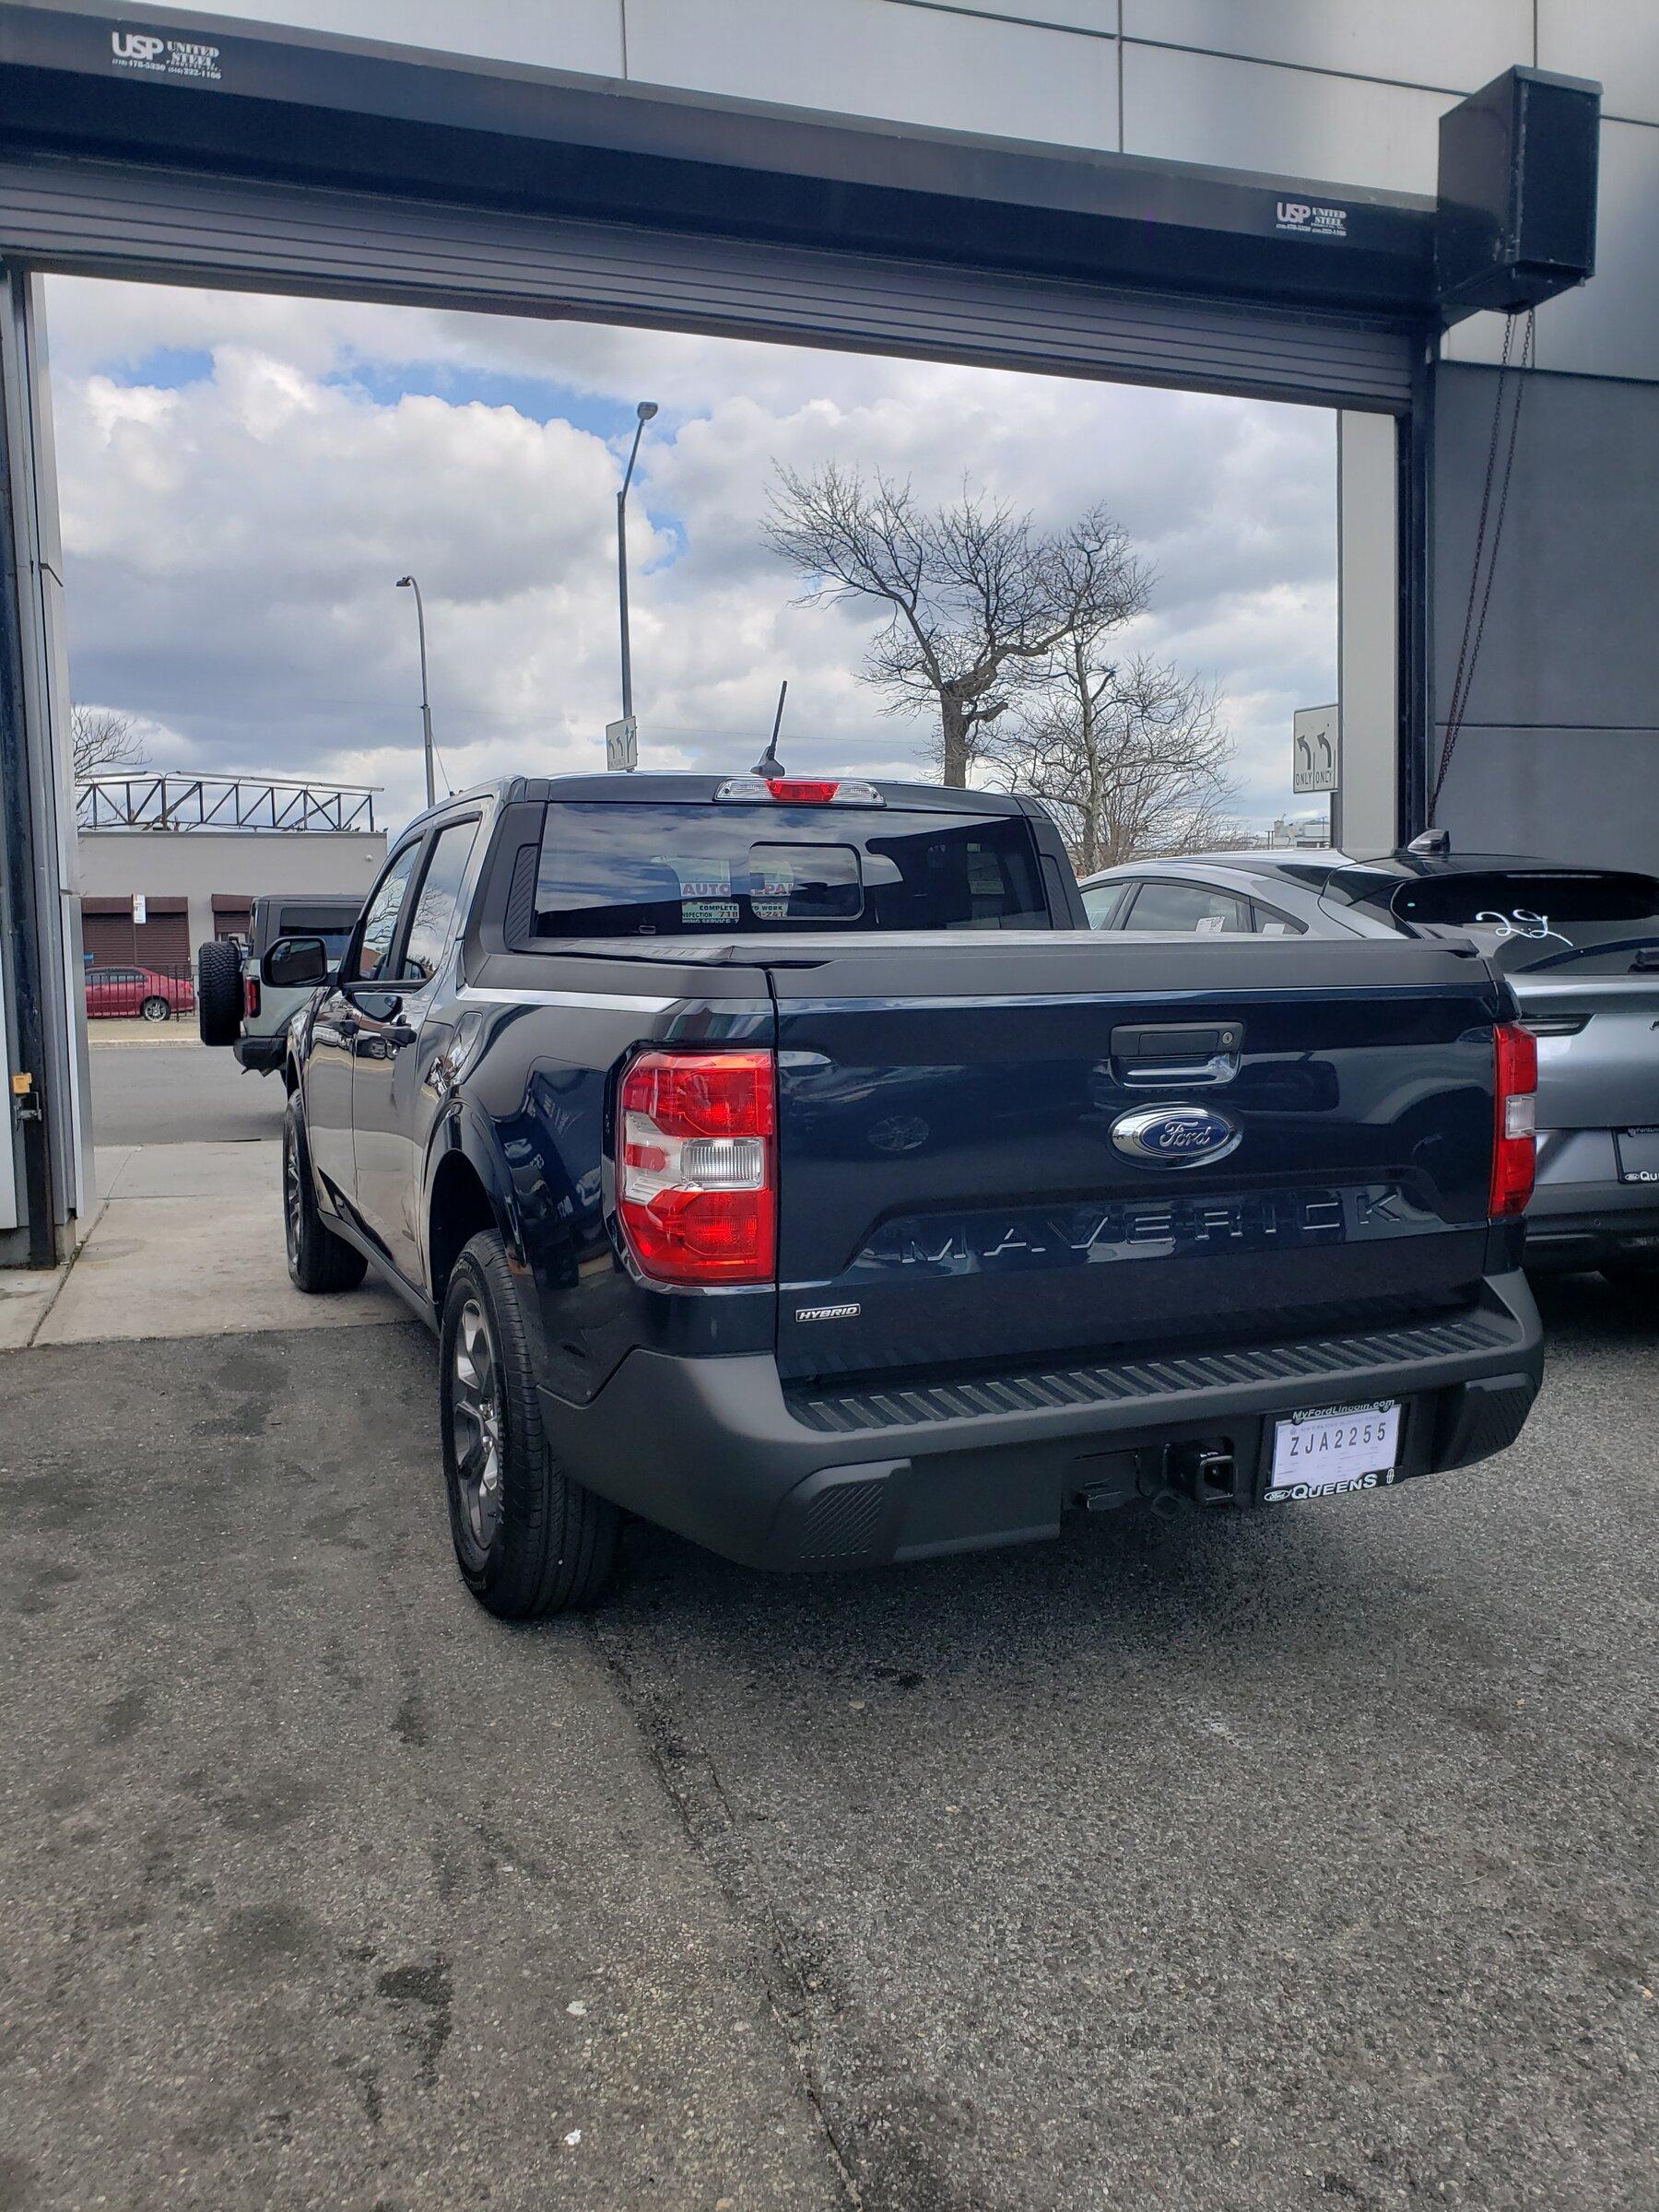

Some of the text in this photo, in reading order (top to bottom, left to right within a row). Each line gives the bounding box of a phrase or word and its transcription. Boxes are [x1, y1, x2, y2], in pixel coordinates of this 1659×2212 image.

[112, 31, 164, 60] USP
[167, 41, 219, 57] UNITED
[171, 53, 212, 66] STEEL
[1277, 202, 1311, 223] USP
[1312, 207, 1347, 219] UNITED
[1295, 771, 1332, 785] ONLY ONLY
[1159, 1122, 1211, 1147] Ford
[901, 1187, 1401, 1263] MAVERICK
[799, 1307, 857, 1320] HYBRID
[1290, 1422, 1385, 1456] ZJA2255
[1291, 1473, 1377, 1500] QUEENS
